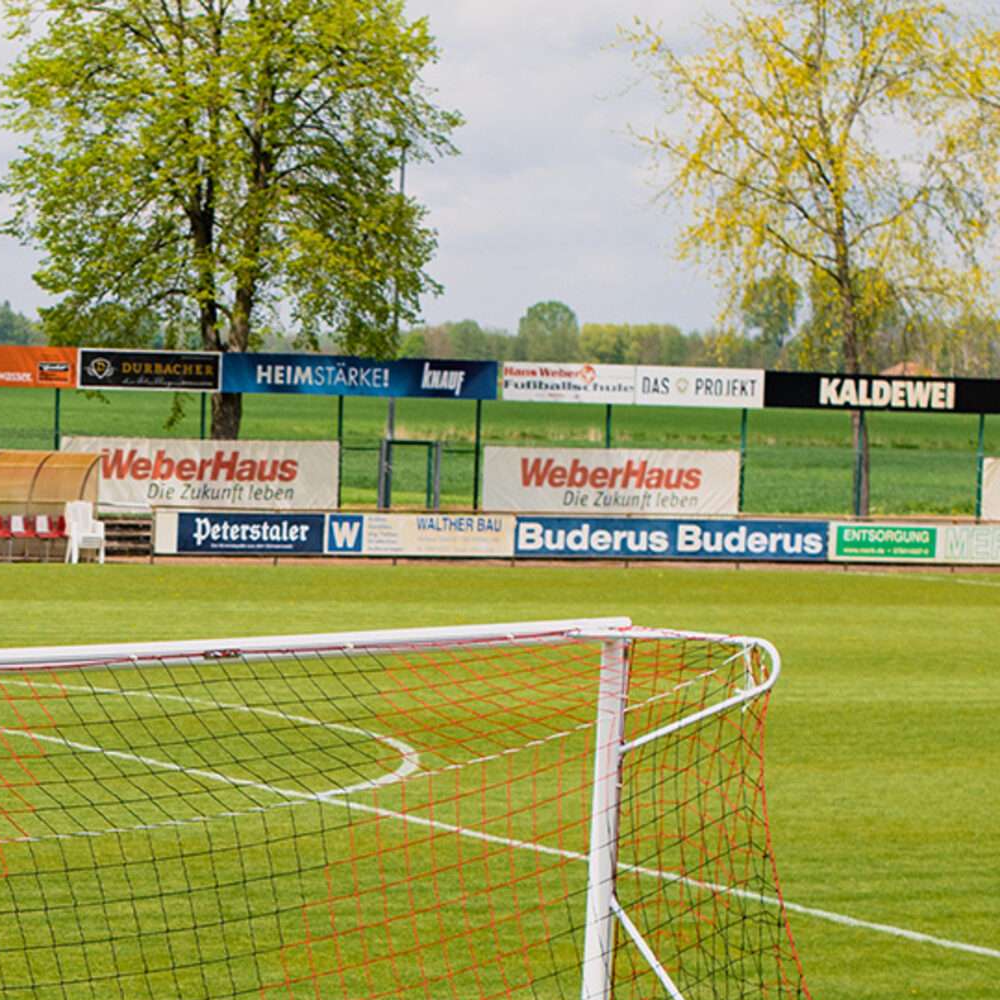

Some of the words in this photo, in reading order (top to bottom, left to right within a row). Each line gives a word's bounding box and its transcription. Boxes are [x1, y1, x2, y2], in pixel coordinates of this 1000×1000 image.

[122, 362, 214, 376] DURBACHER
[256, 362, 390, 388] HEIMSTÄRKE!
[504, 367, 537, 377] Hans
[642, 376, 670, 395] DAS
[695, 378, 757, 397] PROJEKT
[819, 377, 956, 409] KALDEWEI
[101, 448, 299, 482] WeberHaus
[521, 457, 702, 490] WeberHaus
[147, 483, 175, 499] Die
[180, 483, 245, 503] Zukunft
[249, 485, 295, 501] leben
[563, 490, 589, 506] Die
[593, 491, 652, 510] Zukunft
[656, 492, 699, 508] leben
[193, 517, 310, 546] Peterstaler
[331, 521, 361, 549] W
[416, 517, 474, 532] WALTHER
[477, 518, 503, 533] BAU
[843, 528, 931, 544] ENTSORGUNG
[517, 522, 669, 551] Buderus
[677, 524, 824, 554] Buderus
